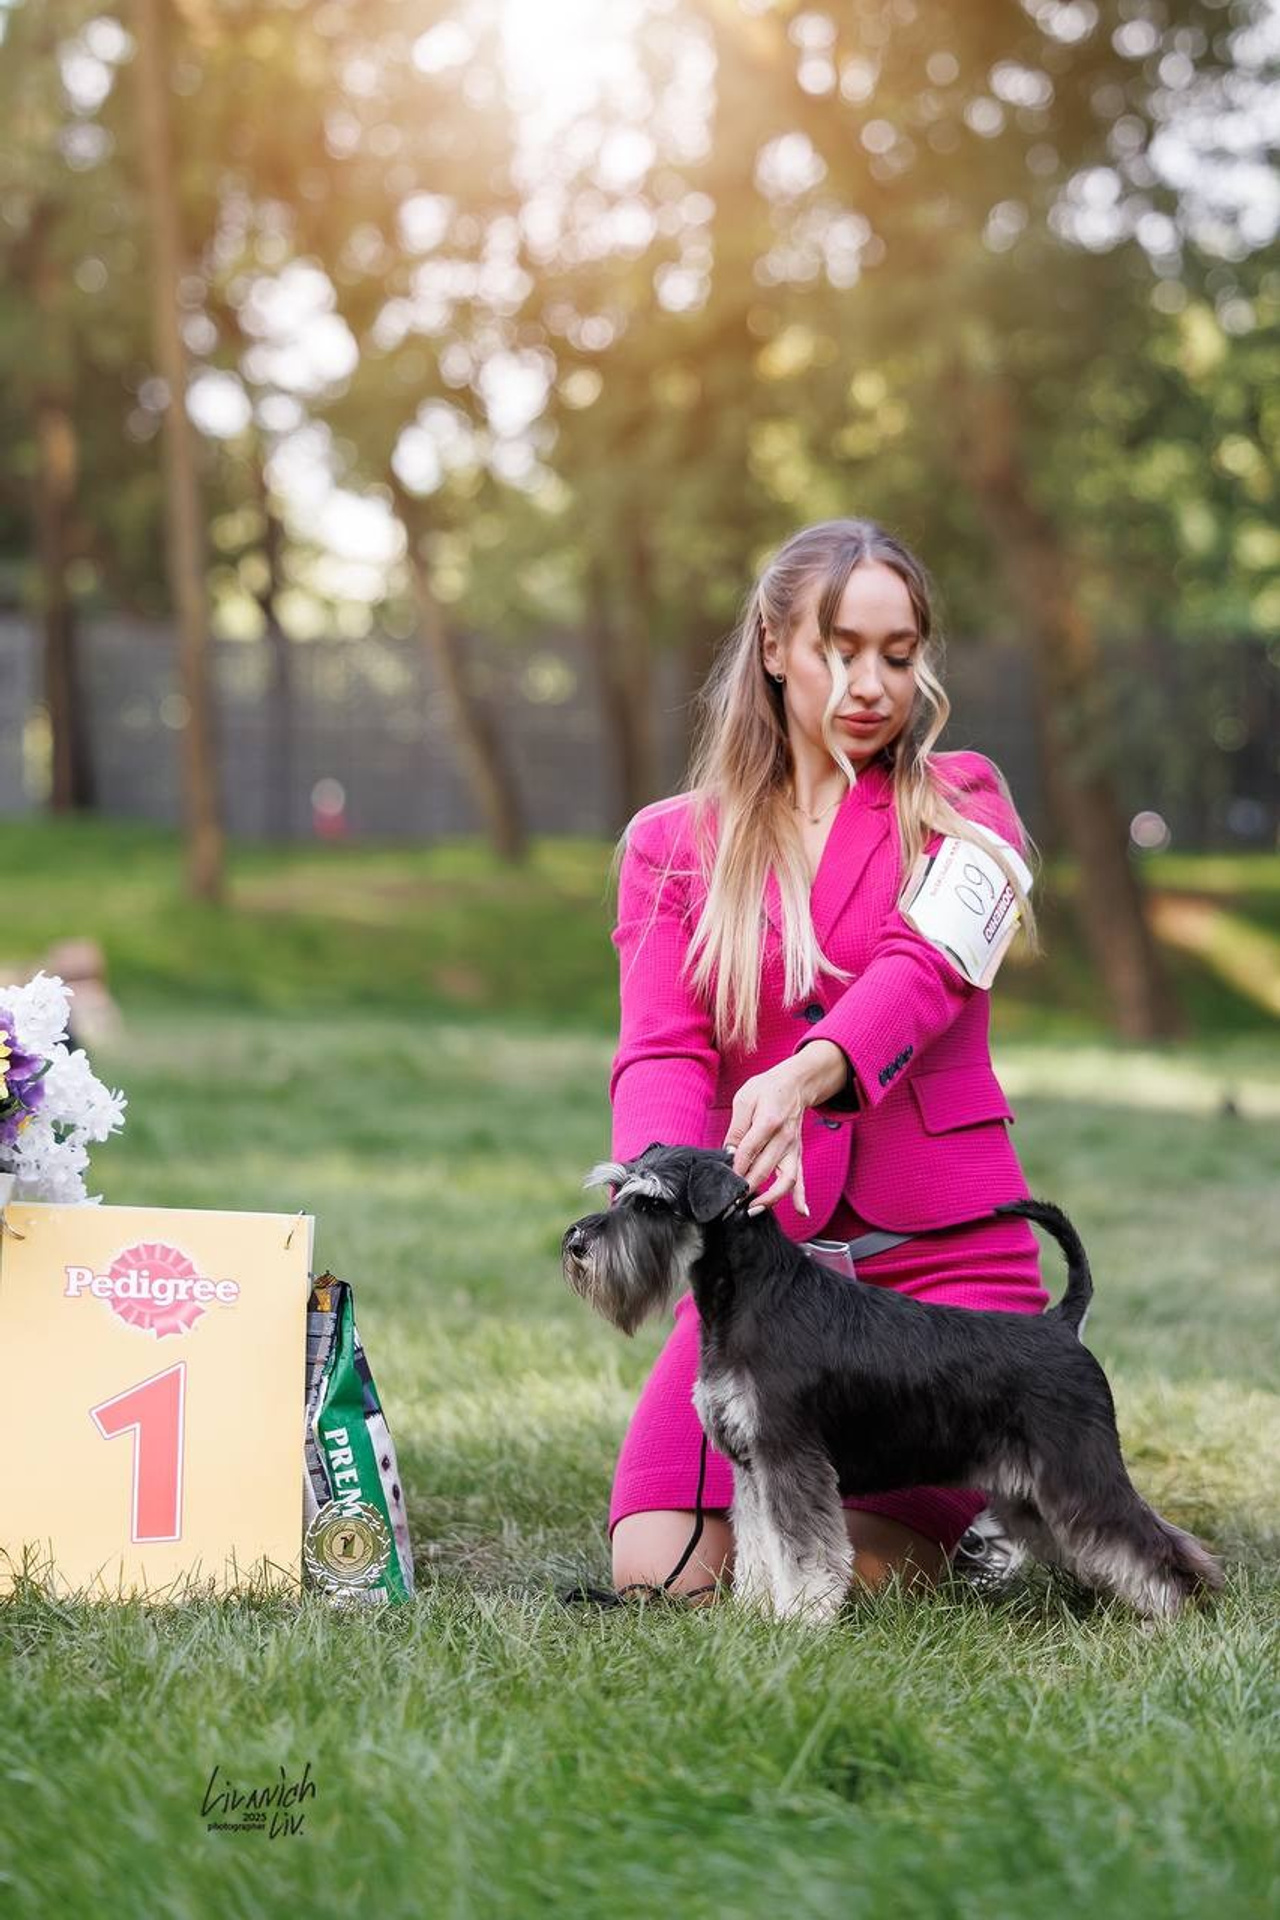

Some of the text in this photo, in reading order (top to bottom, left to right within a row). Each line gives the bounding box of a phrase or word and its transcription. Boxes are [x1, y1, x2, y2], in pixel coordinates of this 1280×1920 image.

[984, 885, 1015, 941] ООМЕНЮ
[65, 1265, 240, 1304] Pedigree
[89, 1360, 187, 1544] 1
[324, 1427, 363, 1517] PREM
[337, 1533, 357, 1560] 1
